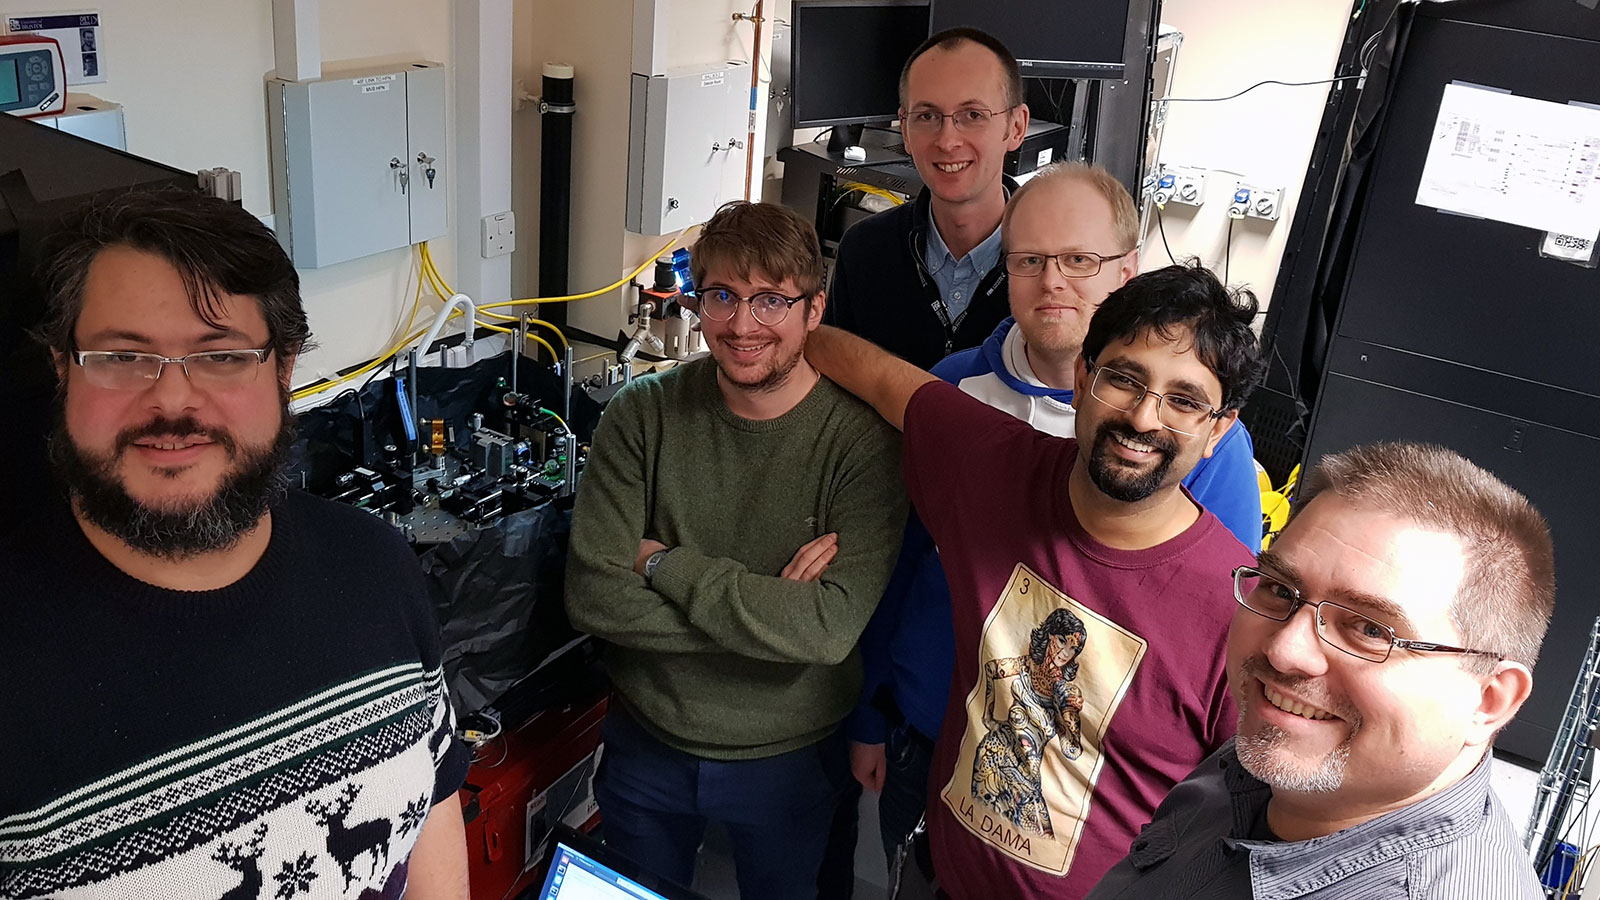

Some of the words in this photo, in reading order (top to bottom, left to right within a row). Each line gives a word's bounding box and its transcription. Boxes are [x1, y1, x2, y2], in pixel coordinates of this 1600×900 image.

[1019, 577, 1030, 595] 3
[959, 796, 974, 823] LA
[980, 814, 1032, 856] DAMA
